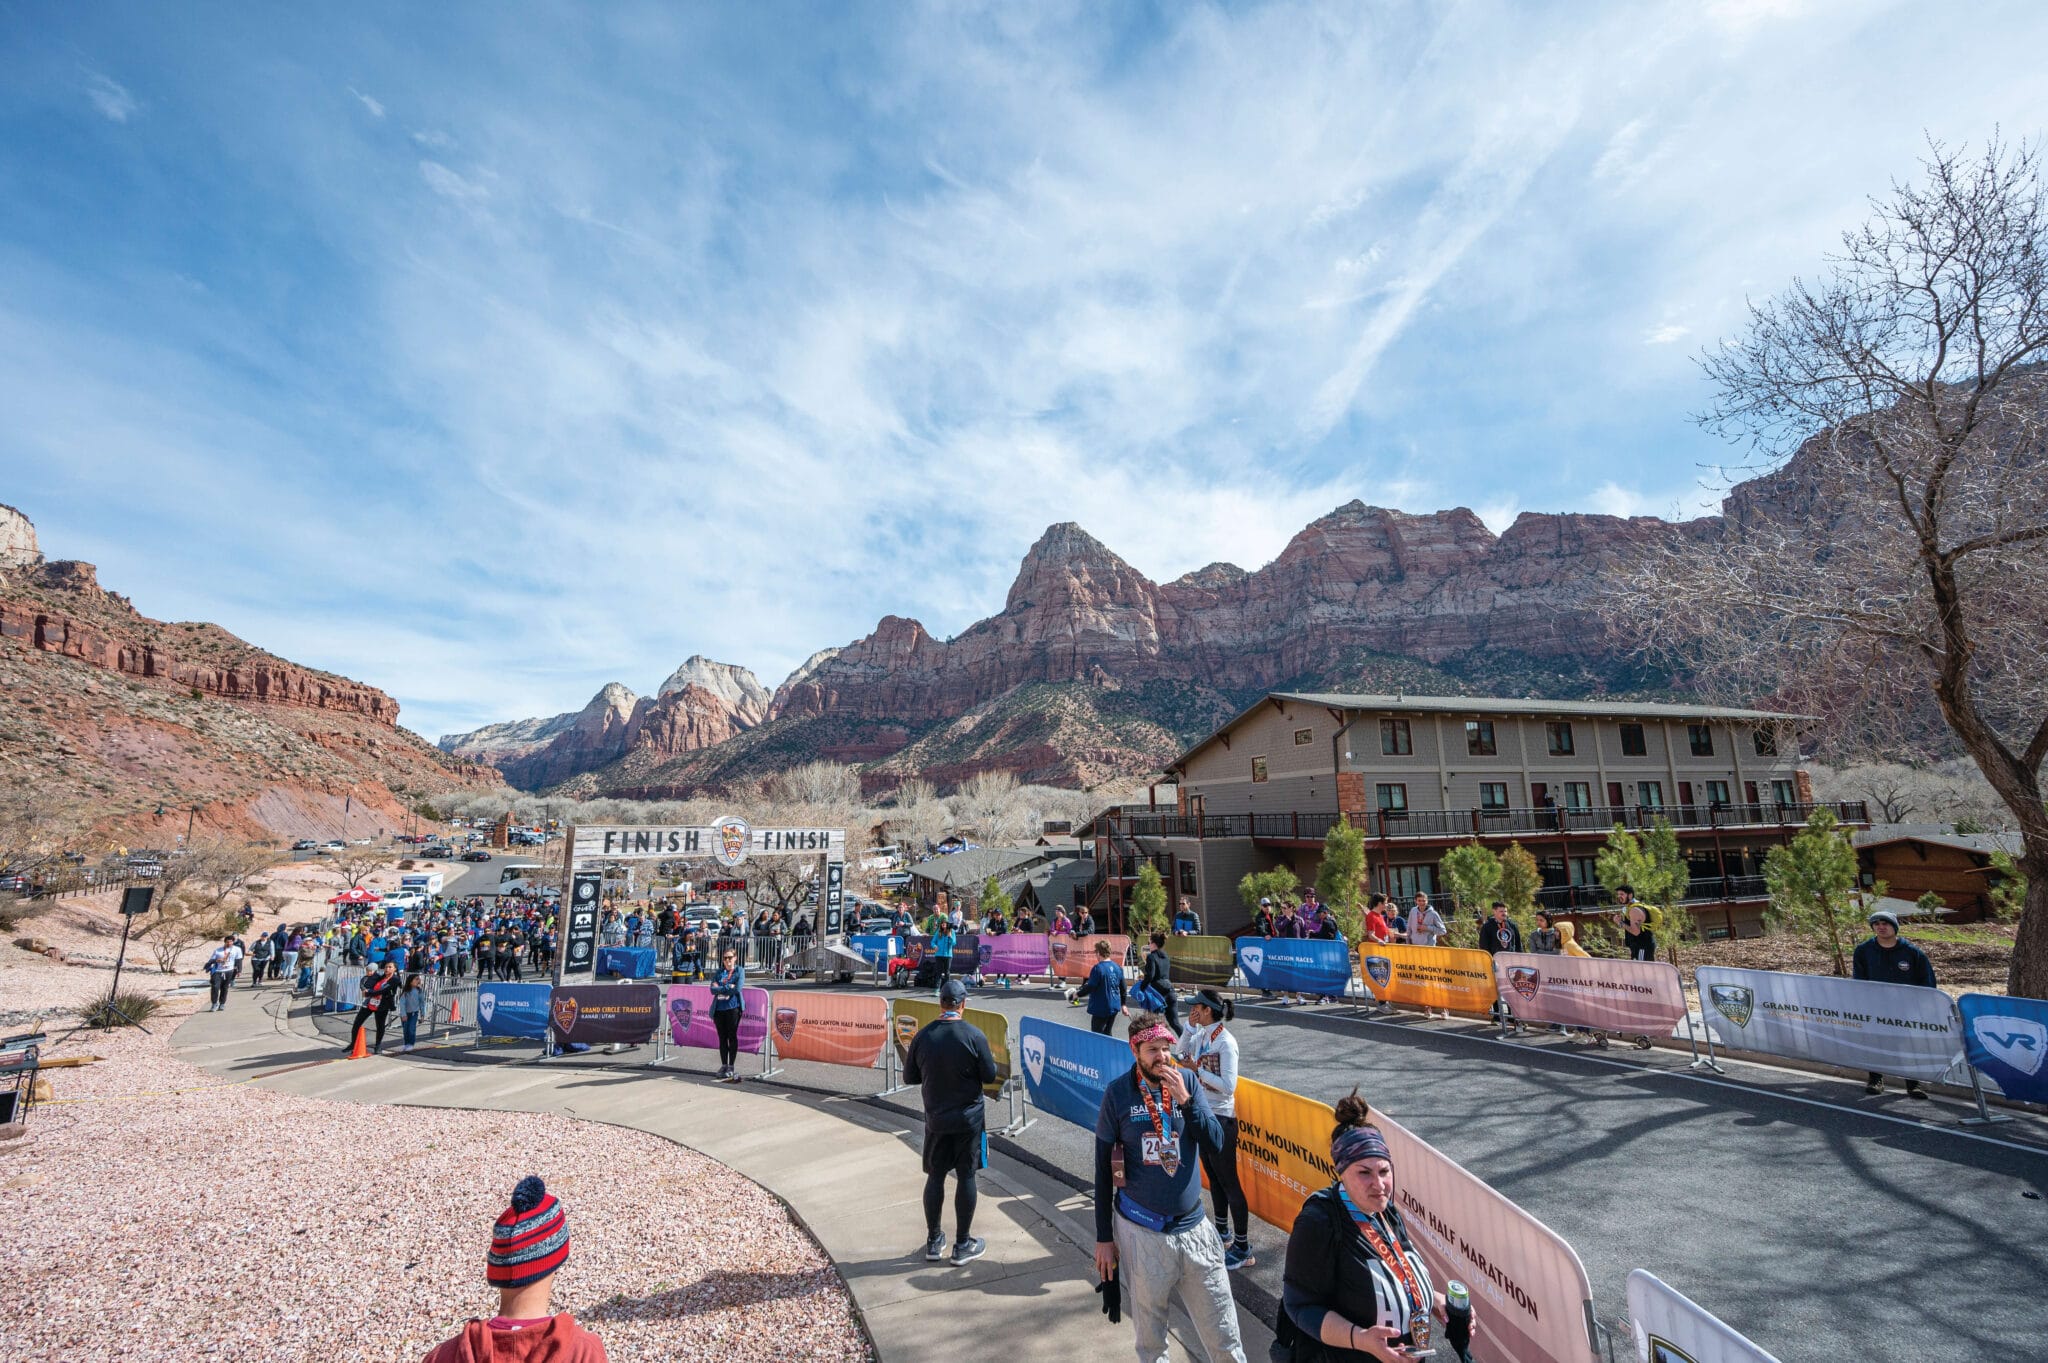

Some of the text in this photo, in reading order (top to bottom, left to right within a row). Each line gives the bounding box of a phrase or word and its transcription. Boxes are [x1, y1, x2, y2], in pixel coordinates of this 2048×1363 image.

[604, 830, 699, 854] FINISH
[764, 831, 830, 850] FINISH
[1244, 954, 1260, 963] VR
[1267, 954, 1314, 964] VACATION RACES
[1395, 963, 1488, 980] GREAT SMOKY MOUNTAINS
[1397, 971, 1453, 984] HALF MARATHON
[1547, 977, 1569, 985] ZION
[1571, 979, 1594, 987] HALF
[1597, 981, 1653, 995] MARATHON
[481, 1001, 493, 1010] VR
[855, 1022, 885, 1030] MARATHON
[1762, 1001, 1949, 1033] GRAND TETON HALF MARATHON
[1815, 1016, 1863, 1029] WYOMING
[1981, 1031, 2037, 1051] VR
[1025, 1047, 1042, 1066] VR
[1049, 1055, 1099, 1079] VACATION RACES
[1236, 1136, 1279, 1167] RATHON
[1238, 1119, 1339, 1181] OKY MOUNTAINS
[1247, 1157, 1309, 1197] TENNESSEE
[1365, 1225, 1398, 1267] ZION
[1402, 1188, 1426, 1220] ZION
[1428, 1211, 1456, 1245] HALF
[1460, 1237, 1539, 1321] MARATHON
